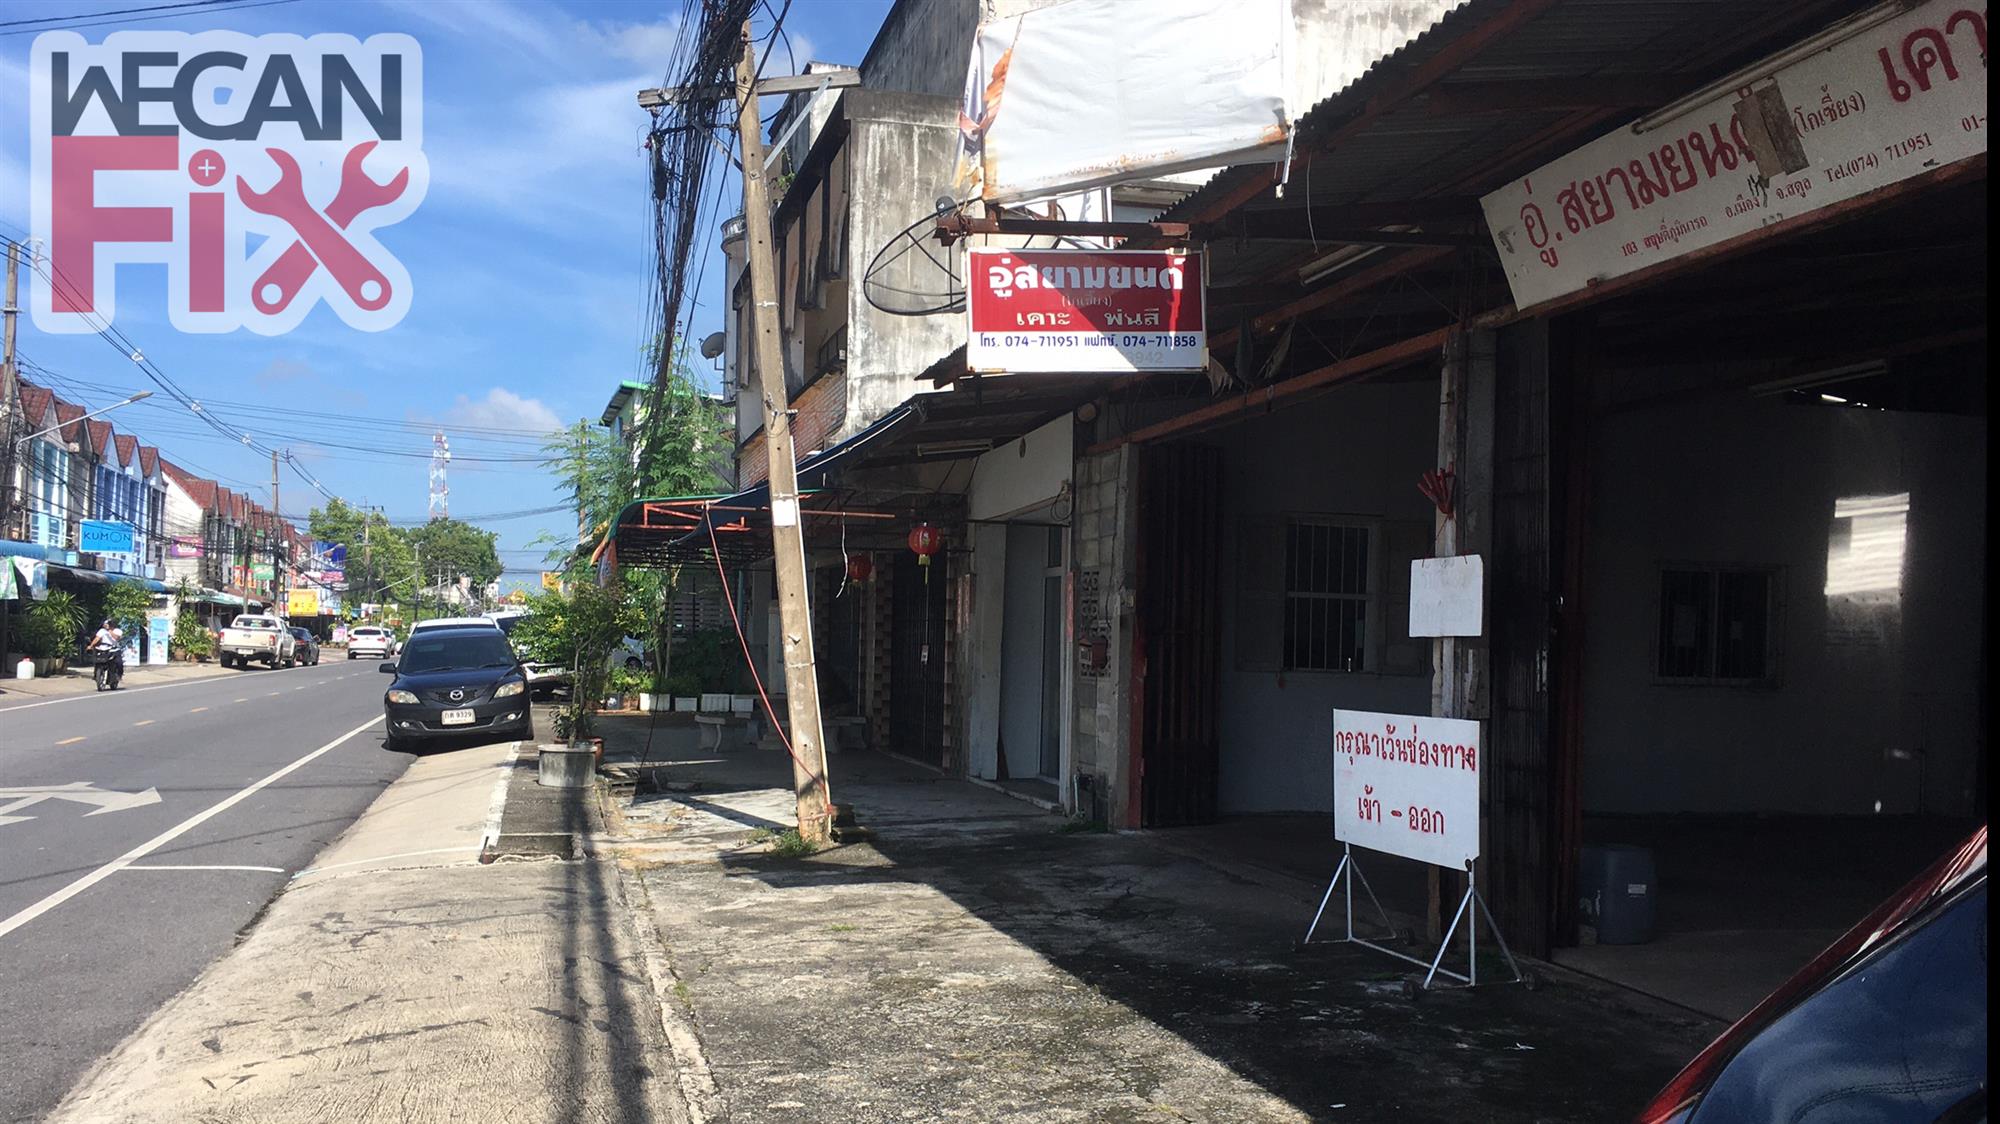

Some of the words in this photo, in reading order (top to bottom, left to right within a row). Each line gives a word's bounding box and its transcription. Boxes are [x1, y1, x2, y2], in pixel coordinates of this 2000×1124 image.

[1793, 83, 1866, 139] (โกเซี้ยง)
[1877, 9, 1988, 103] เคา
[1621, 241, 1639, 257] 103
[1775, 176, 1813, 201] จ.สตูล
[1884, 132, 1934, 162] 711951
[988, 257, 1187, 299] อู่สยามยนต์
[1016, 311, 1071, 326] เคาะ
[1104, 307, 1160, 326] พ่นสี
[980, 332, 1001, 347] โทร.
[1005, 335, 1079, 348] 074-711951
[1122, 335, 1197, 348] 074-711858
[83, 531, 131, 543] KUMON
[1335, 723, 1477, 771] กรุณาเว้นช่องทาง
[1357, 784, 1382, 823] เข้า
[1408, 805, 1446, 835] ออก
